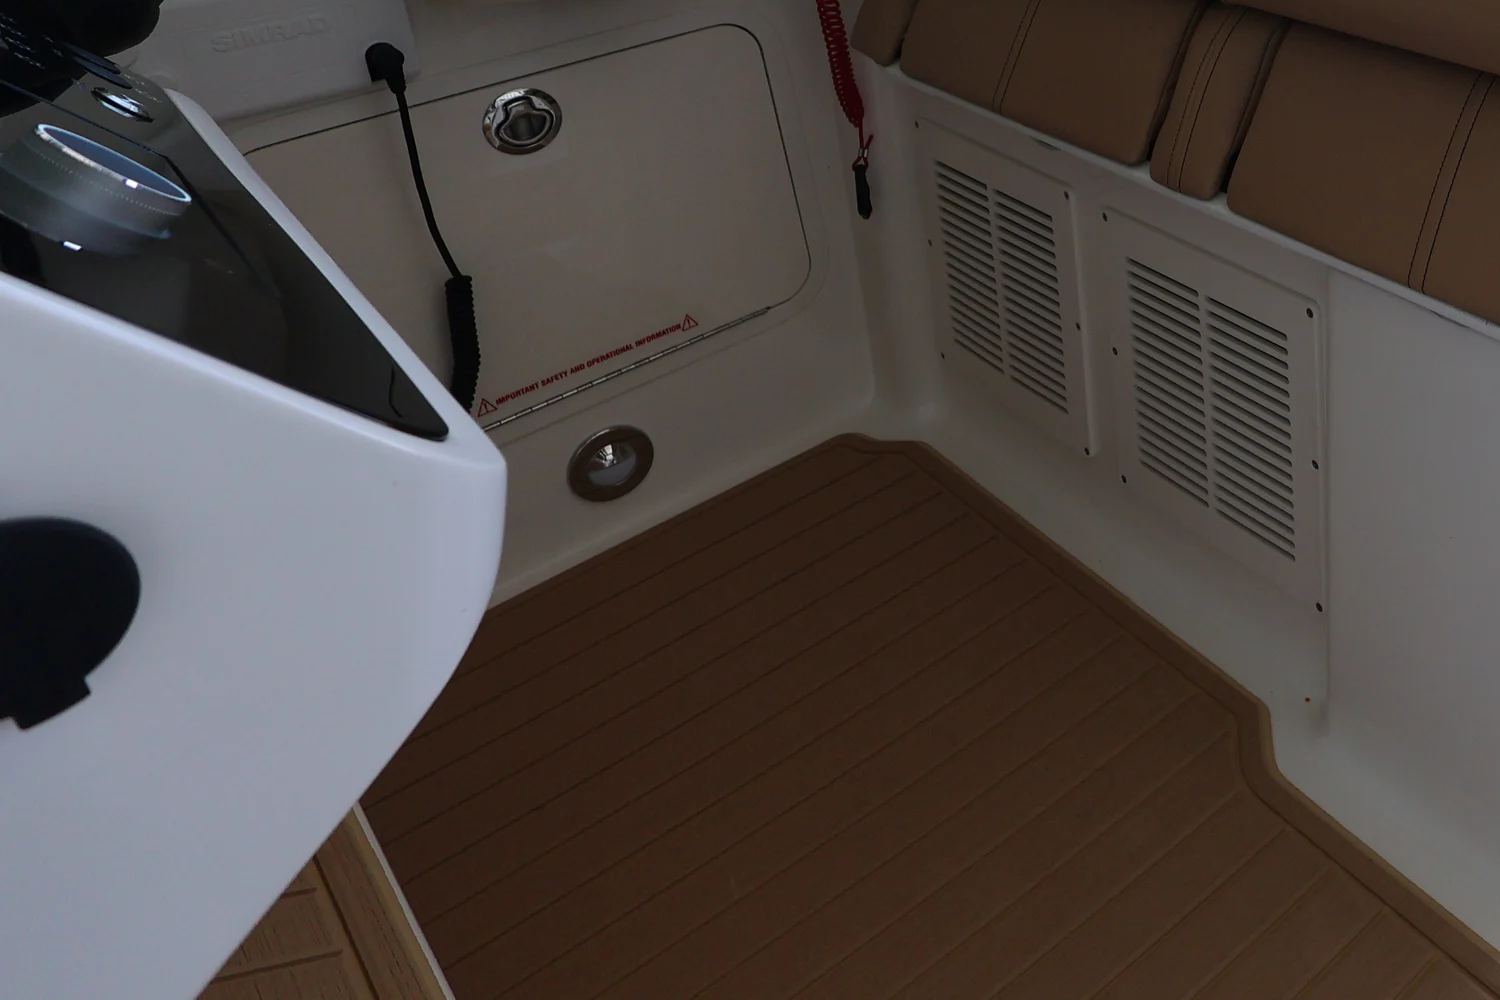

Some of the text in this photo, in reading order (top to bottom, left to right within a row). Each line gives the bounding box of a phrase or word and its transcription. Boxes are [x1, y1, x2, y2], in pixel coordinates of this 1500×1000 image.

[495, 323, 682, 406] IMPORTANT SAFETY AND OPERATIONAL INFORMATION
